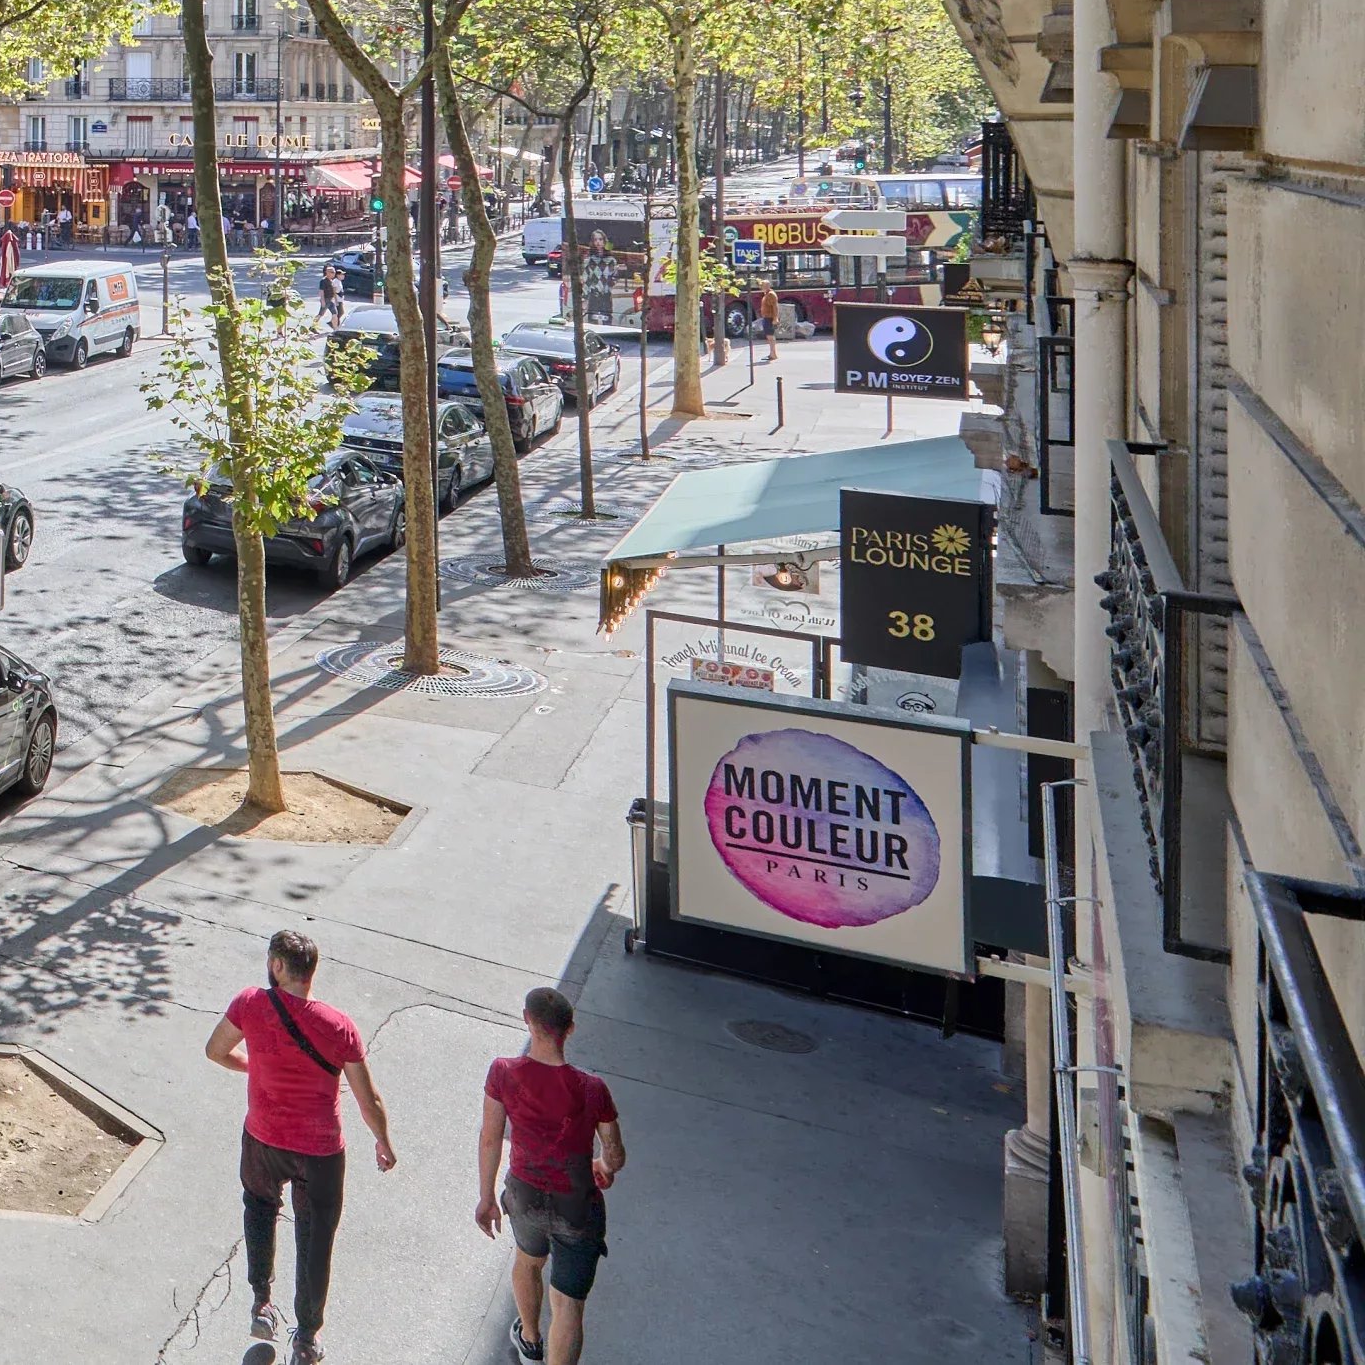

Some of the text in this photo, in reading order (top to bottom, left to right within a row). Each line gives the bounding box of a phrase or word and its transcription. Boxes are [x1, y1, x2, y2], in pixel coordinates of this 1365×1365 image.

[225, 133, 248, 148] LE
[22, 152, 80, 163] TRATTORIA
[736, 248, 760, 258] TAXIS
[891, 372, 933, 384] SOYEZ
[934, 375, 961, 386] ZEN
[892, 384, 929, 392] INSTITUT
[851, 526, 929, 552] PARIS
[851, 545, 971, 577] LOUNGE
[887, 610, 936, 642] 38
[661, 639, 803, 689] French Artianal Ice Cream
[723, 763, 907, 826] MOMENT
[724, 805, 910, 871] COULEUR
[766, 859, 870, 892] PARIS
